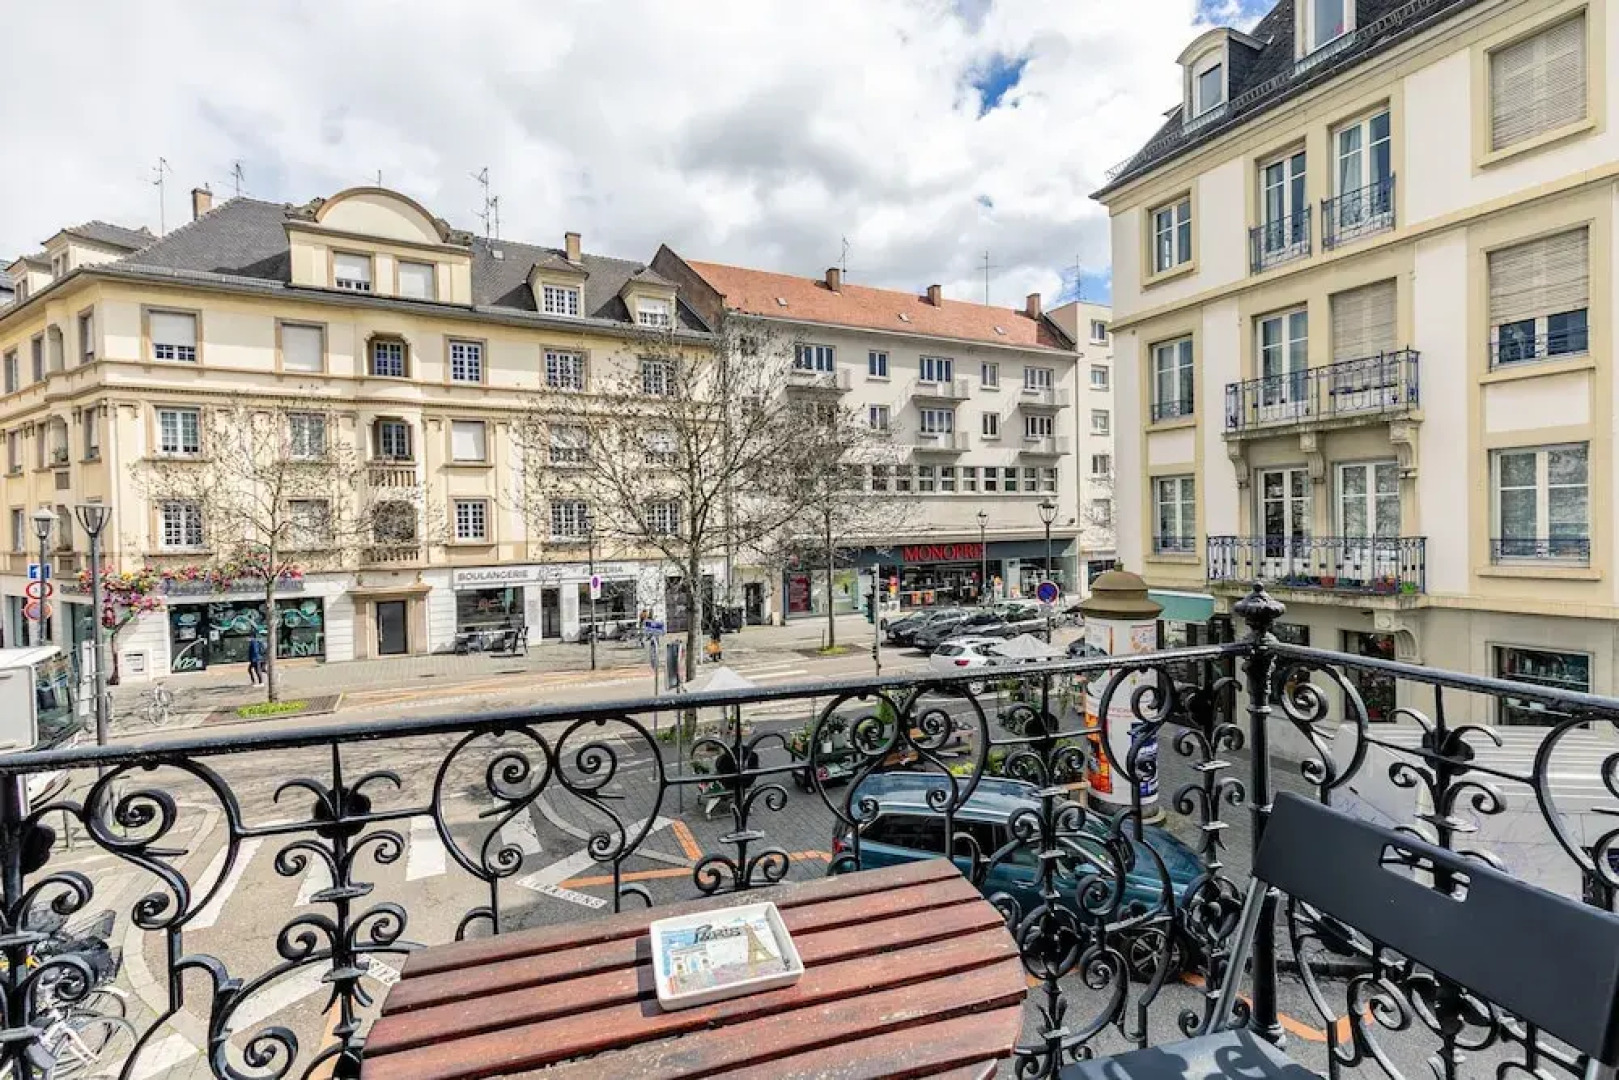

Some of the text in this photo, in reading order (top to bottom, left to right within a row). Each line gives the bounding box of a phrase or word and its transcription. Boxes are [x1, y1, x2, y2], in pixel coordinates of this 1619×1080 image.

[903, 543, 983, 561] MONOPRI
[457, 569, 529, 582] BOULANGERIE
[582, 564, 624, 575] PZZERIA
